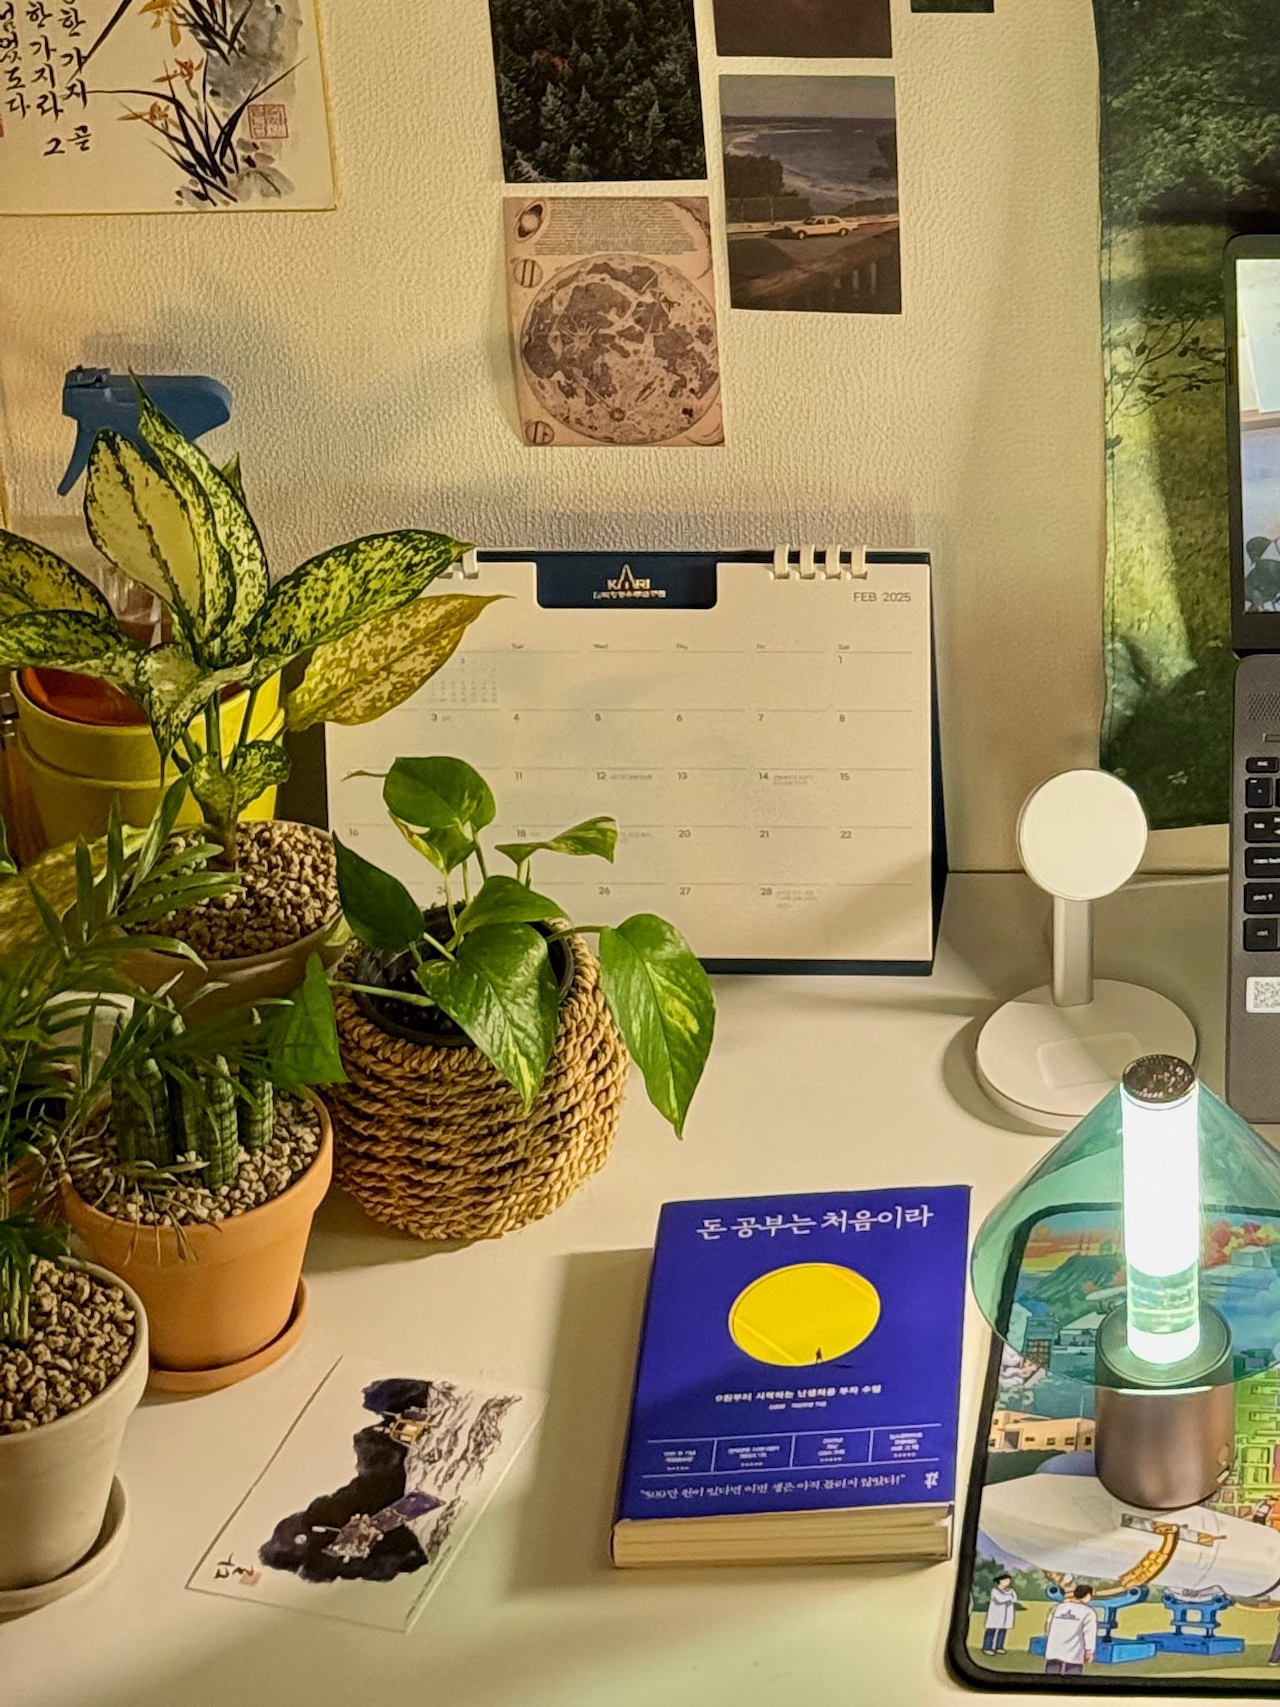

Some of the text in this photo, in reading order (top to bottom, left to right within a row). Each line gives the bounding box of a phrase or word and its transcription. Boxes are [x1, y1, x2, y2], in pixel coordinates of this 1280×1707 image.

[853, 592, 912, 602] FEB 2025
[513, 713, 520, 722] 4
[676, 713, 683, 722] 6
[839, 714, 846, 723] 8
[515, 771, 523, 780] 11
[596, 771, 607, 780] 12
[677, 771, 688, 780] 13
[758, 772, 769, 780] 14
[840, 772, 850, 781] 15
[516, 829, 527, 838] 18
[678, 829, 691, 838] 20
[758, 830, 770, 838] 21
[840, 830, 852, 839] 22
[598, 886, 610, 895] 26
[679, 887, 691, 896] 27
[761, 887, 772, 896] 28
[696, 1204, 935, 1240] 돈 공부는 처음이라
